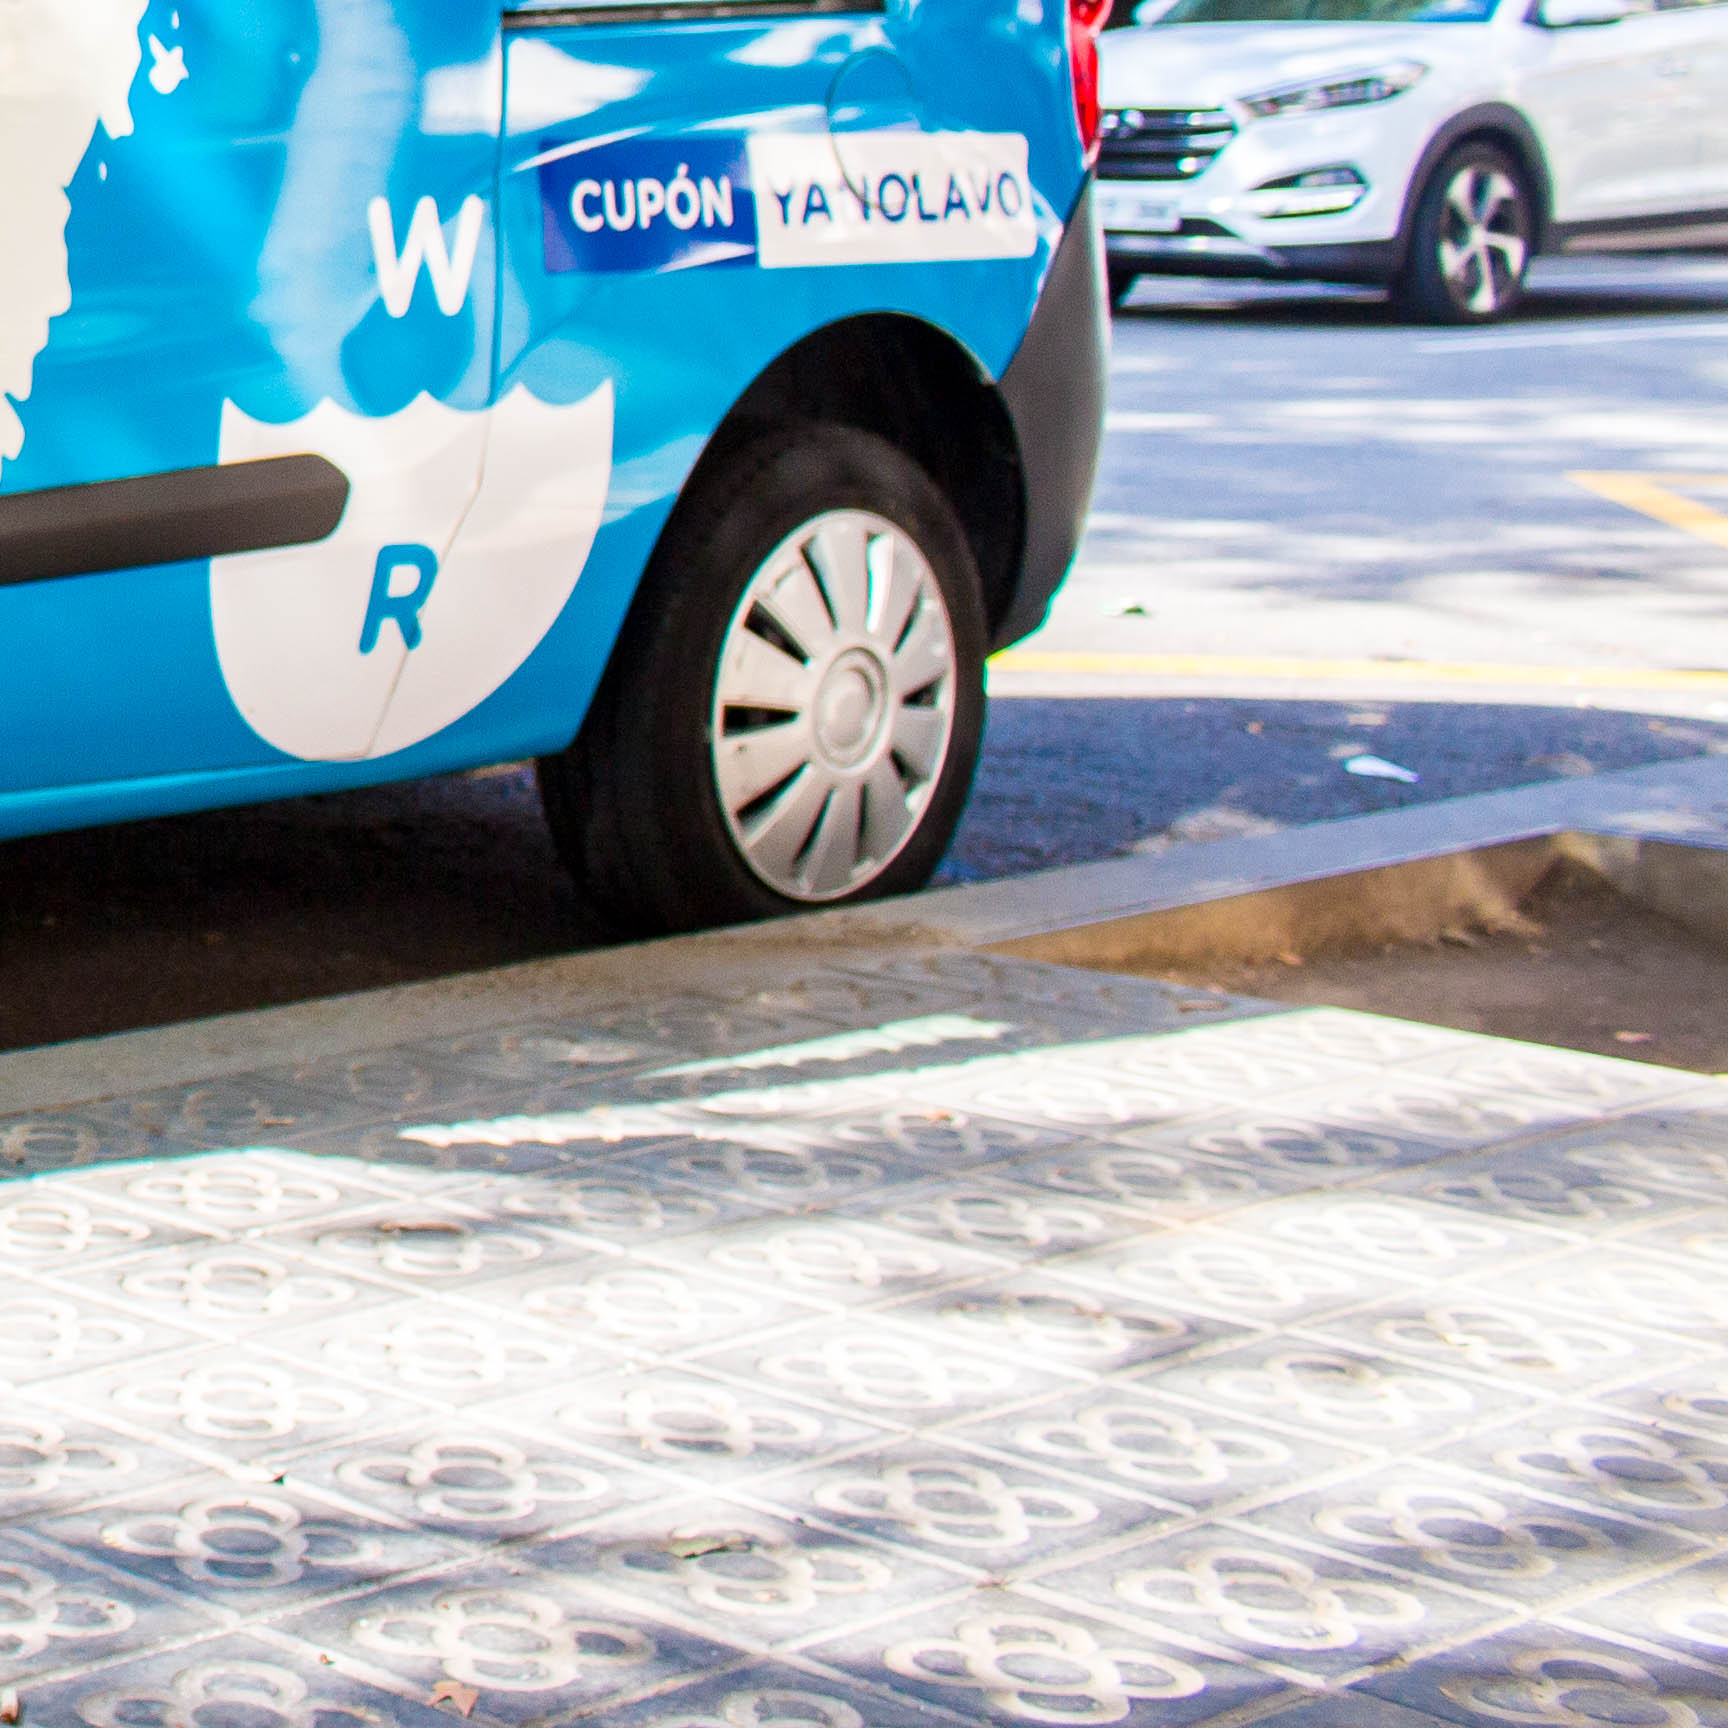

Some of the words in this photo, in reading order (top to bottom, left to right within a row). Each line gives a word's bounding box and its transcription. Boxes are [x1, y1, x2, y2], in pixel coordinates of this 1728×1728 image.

[569, 163, 735, 233] CUPÓN
[367, 193, 484, 319] W
[358, 543, 439, 655] R
